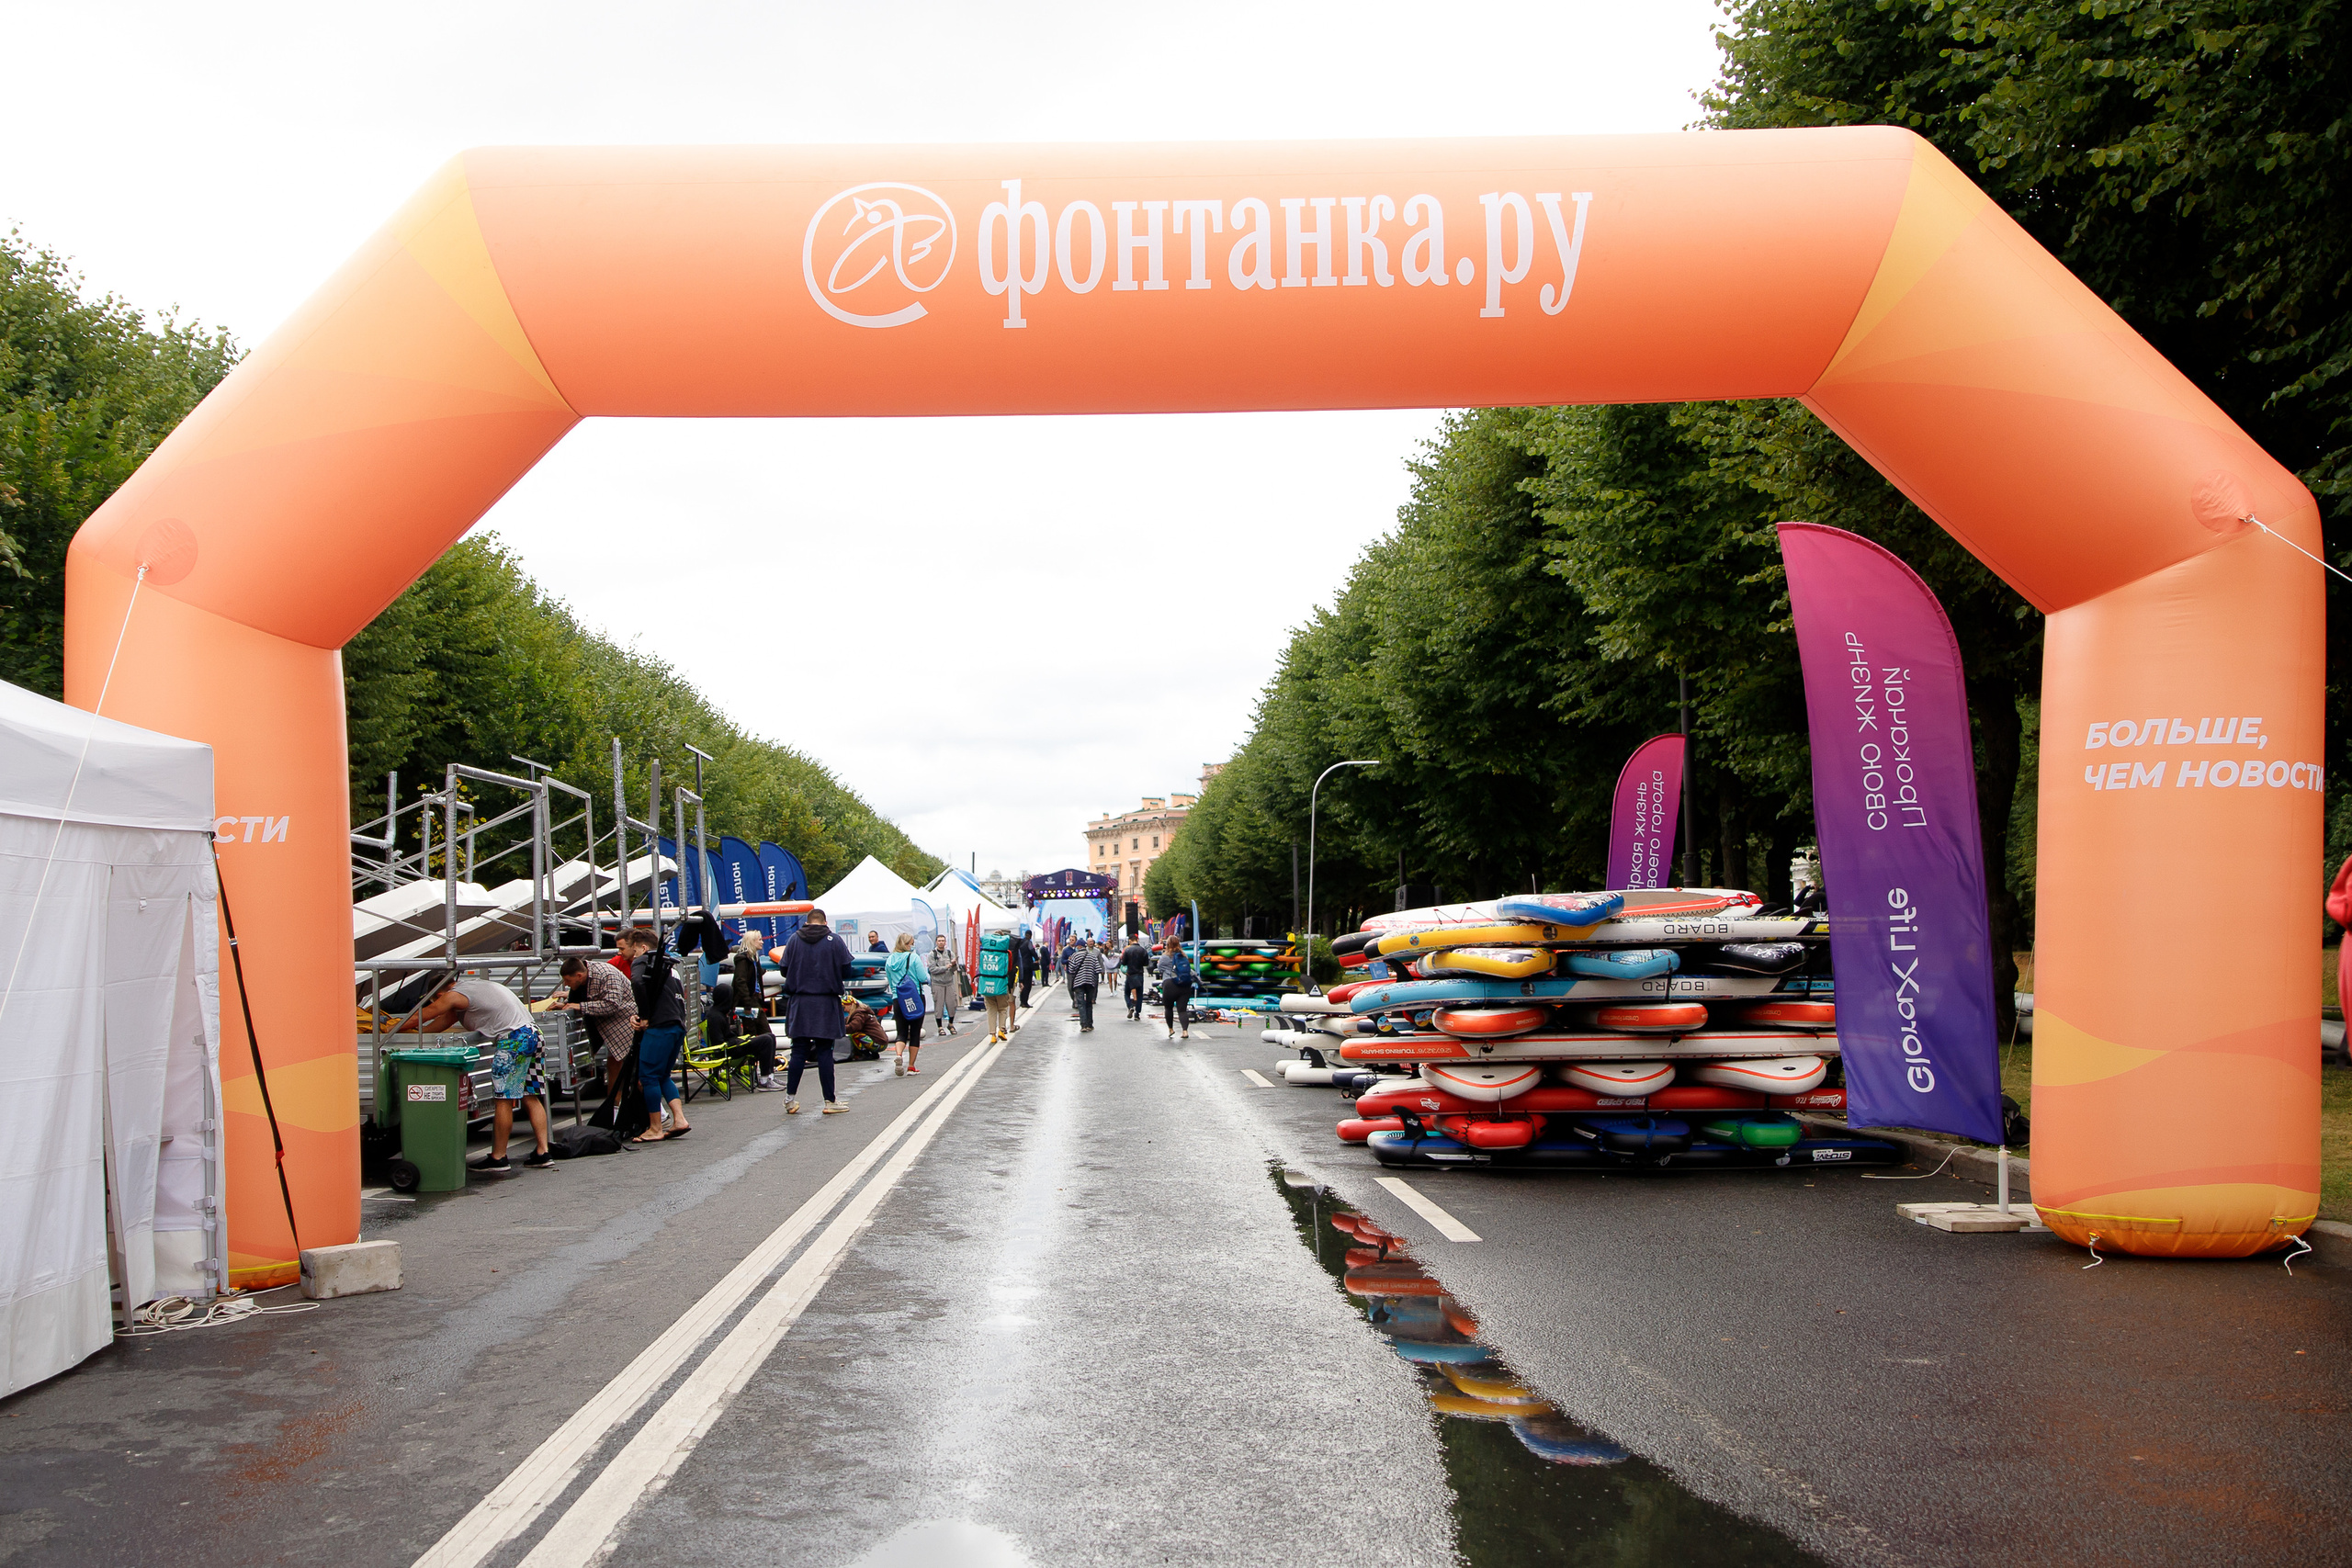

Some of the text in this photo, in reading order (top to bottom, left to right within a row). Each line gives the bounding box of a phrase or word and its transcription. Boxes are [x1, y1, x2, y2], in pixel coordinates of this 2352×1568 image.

[978, 179, 1593, 329] фонтанка.ру
[2085, 716, 2268, 750] БОЛЬШЕ,
[2084, 761, 2166, 791] ЧЕМ
[212, 816, 290, 843] СТИ
[1634, 782, 1647, 838] жизнь
[1646, 770, 1665, 891] воего города
